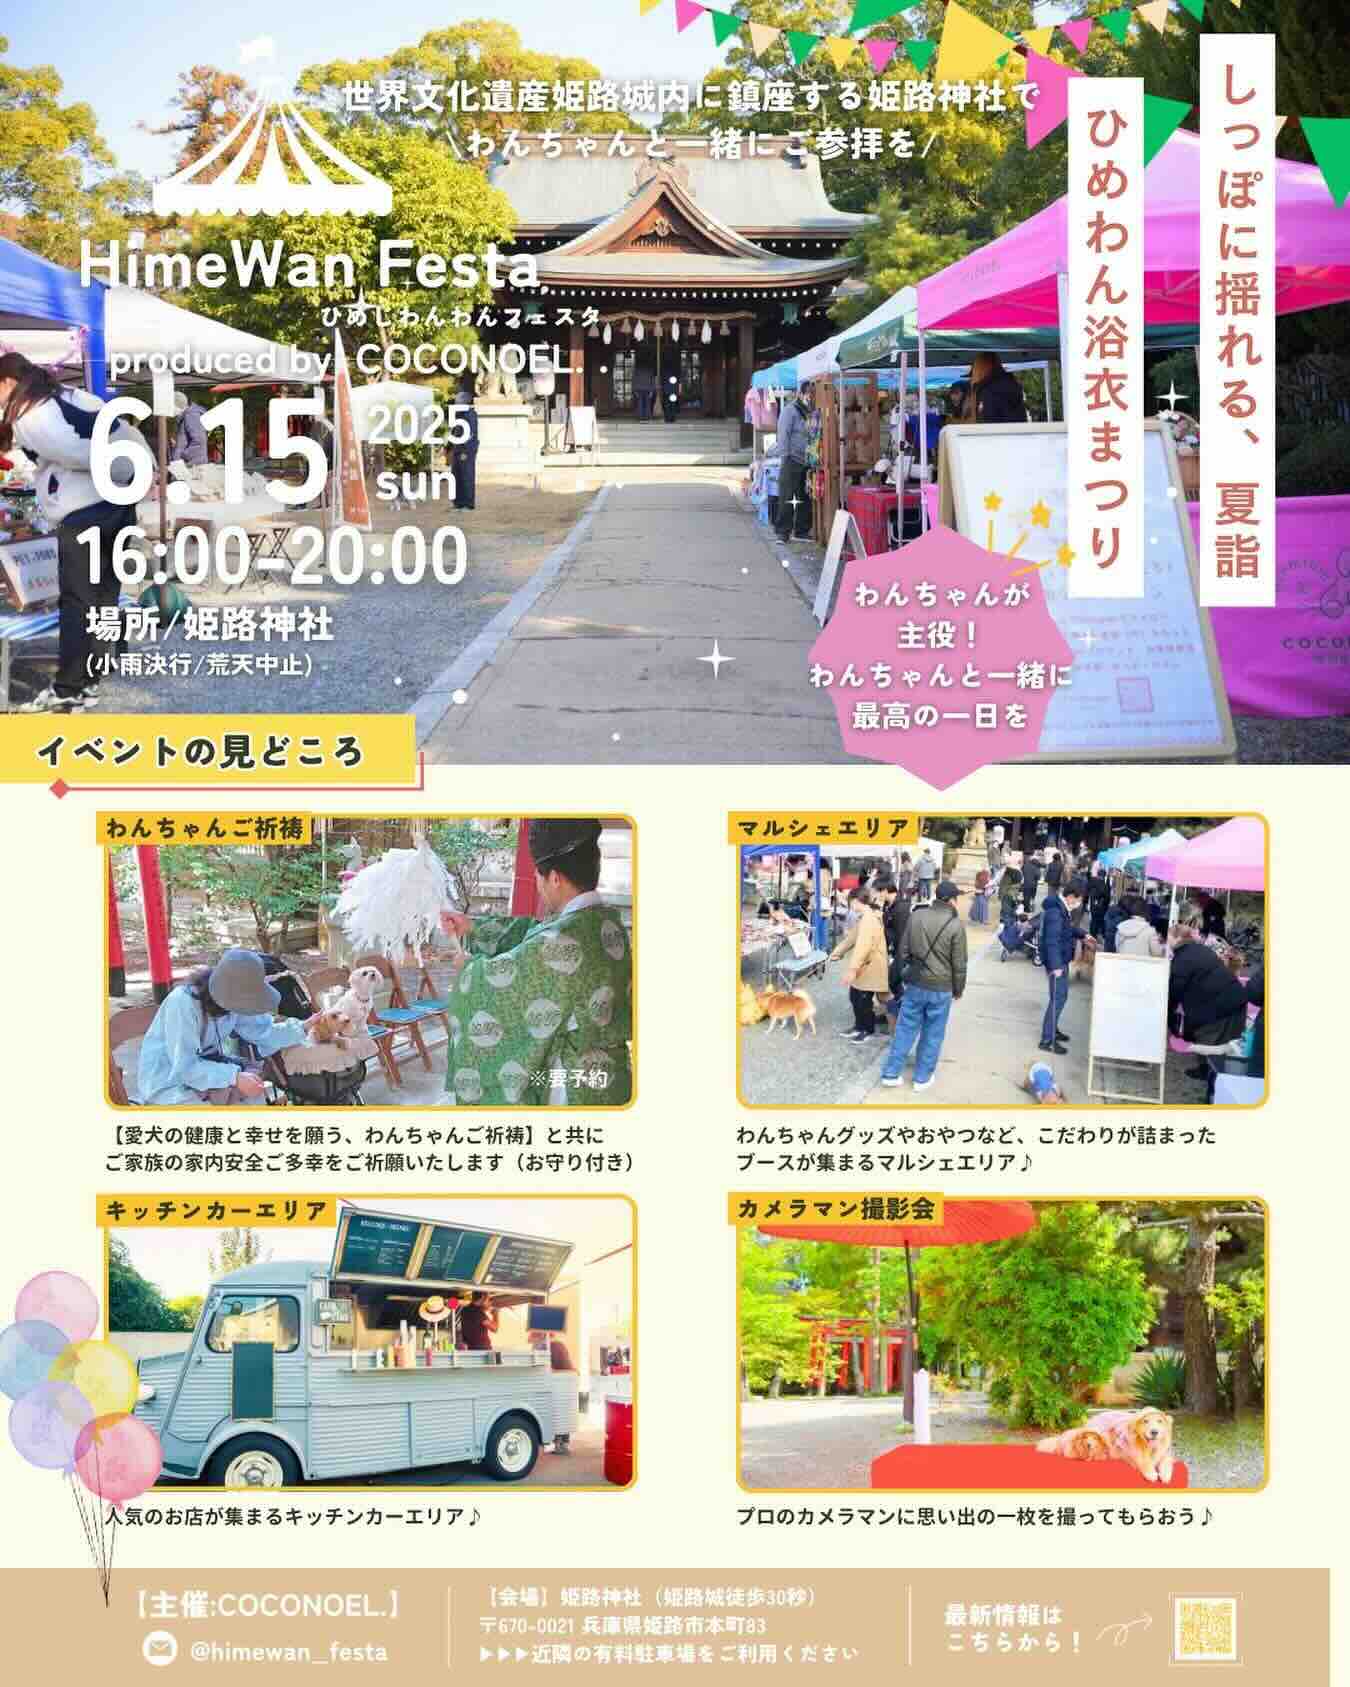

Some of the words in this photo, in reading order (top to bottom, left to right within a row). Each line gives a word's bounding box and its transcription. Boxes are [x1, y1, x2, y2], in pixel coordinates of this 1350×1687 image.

[342, 79, 1041, 113] 世界文化遺産姫路城内に鎮座する姫路神社で
[80, 239, 356, 289] HimeWan
[379, 239, 540, 289] Festa
[1215, 62, 1262, 580] しっぽに揺れる、夏詣
[1082, 107, 1129, 570] ひめわん浴衣まつり
[110, 344, 276, 381] produced
[289, 344, 331, 381] by
[368, 404, 472, 444] 2025
[89, 396, 329, 505] 6.15
[376, 471, 457, 501] sun
[76, 525, 468, 585] 16:00-20:00
[855, 583, 1031, 608] わんちゃんが
[86, 606, 334, 642] 場所/姫路神社
[897, 622, 977, 648] 主役！
[1282, 638, 1350, 650] COCO
[85, 653, 313, 678] (小雨決行/荒天中止)
[809, 662, 1073, 689] わんちゃんと一緒に
[852, 702, 1028, 730] 最高の一日を
[37, 734, 364, 770] イベントの見どころ
[106, 816, 304, 841] わんちゃんご祈祷
[737, 818, 908, 839] マルシェエリア
[530, 1068, 608, 1090] ※要予約
[736, 1124, 1217, 1146] わんちゃんグッズやおやつなど、こだわりが詰まった
[106, 1199, 327, 1222] キッチンカーエリア
[738, 1197, 936, 1221] カメラマン撮影会
[944, 1603, 1063, 1626] 最新情報は
[947, 1630, 1082, 1654] こちらから！
